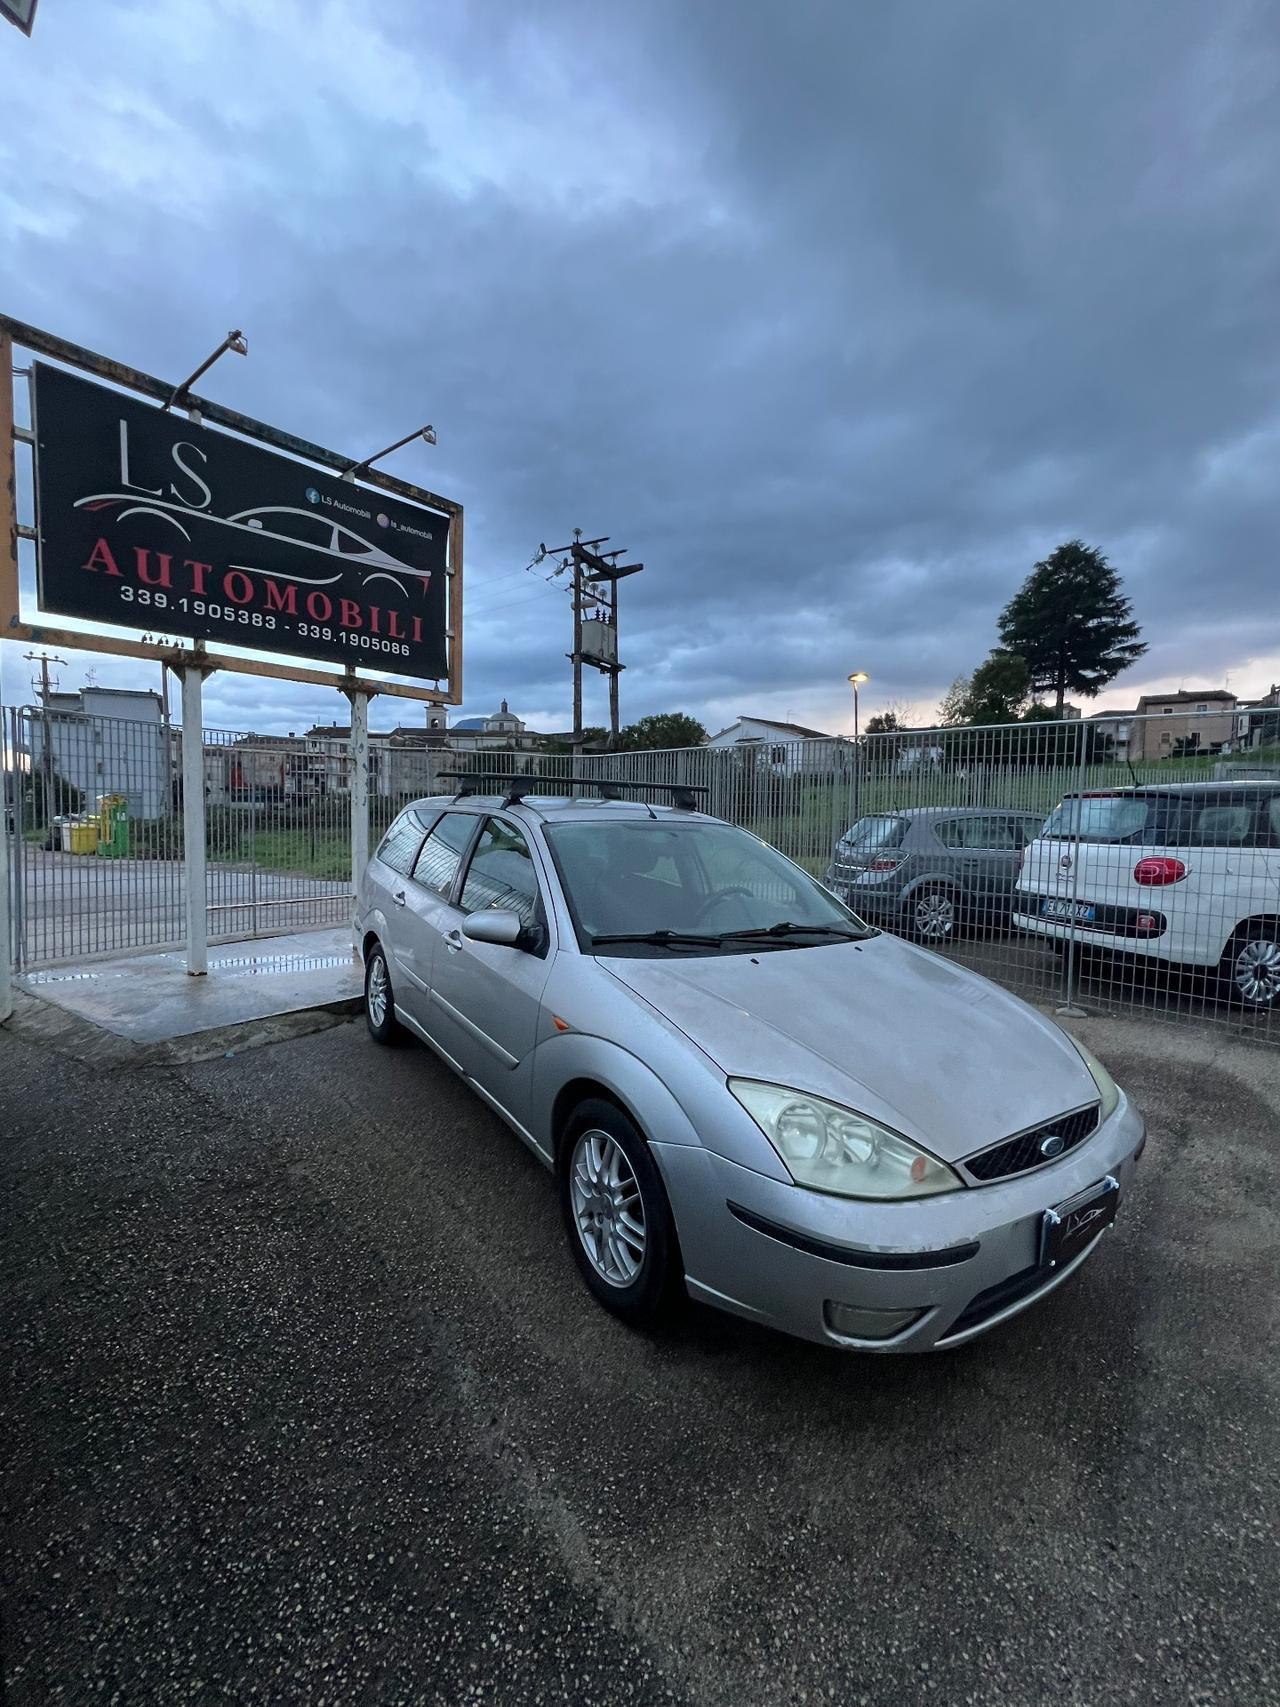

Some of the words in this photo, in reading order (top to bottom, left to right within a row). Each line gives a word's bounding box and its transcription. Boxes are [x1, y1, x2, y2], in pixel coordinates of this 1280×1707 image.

[119, 419, 212, 509] LS
[321, 495, 333, 506] LS
[333, 500, 372, 520] Automobili
[81, 537, 425, 643] AUTOMOBILI
[120, 585, 277, 630] 339.1905383
[297, 622, 411, 656] 339.1905086
